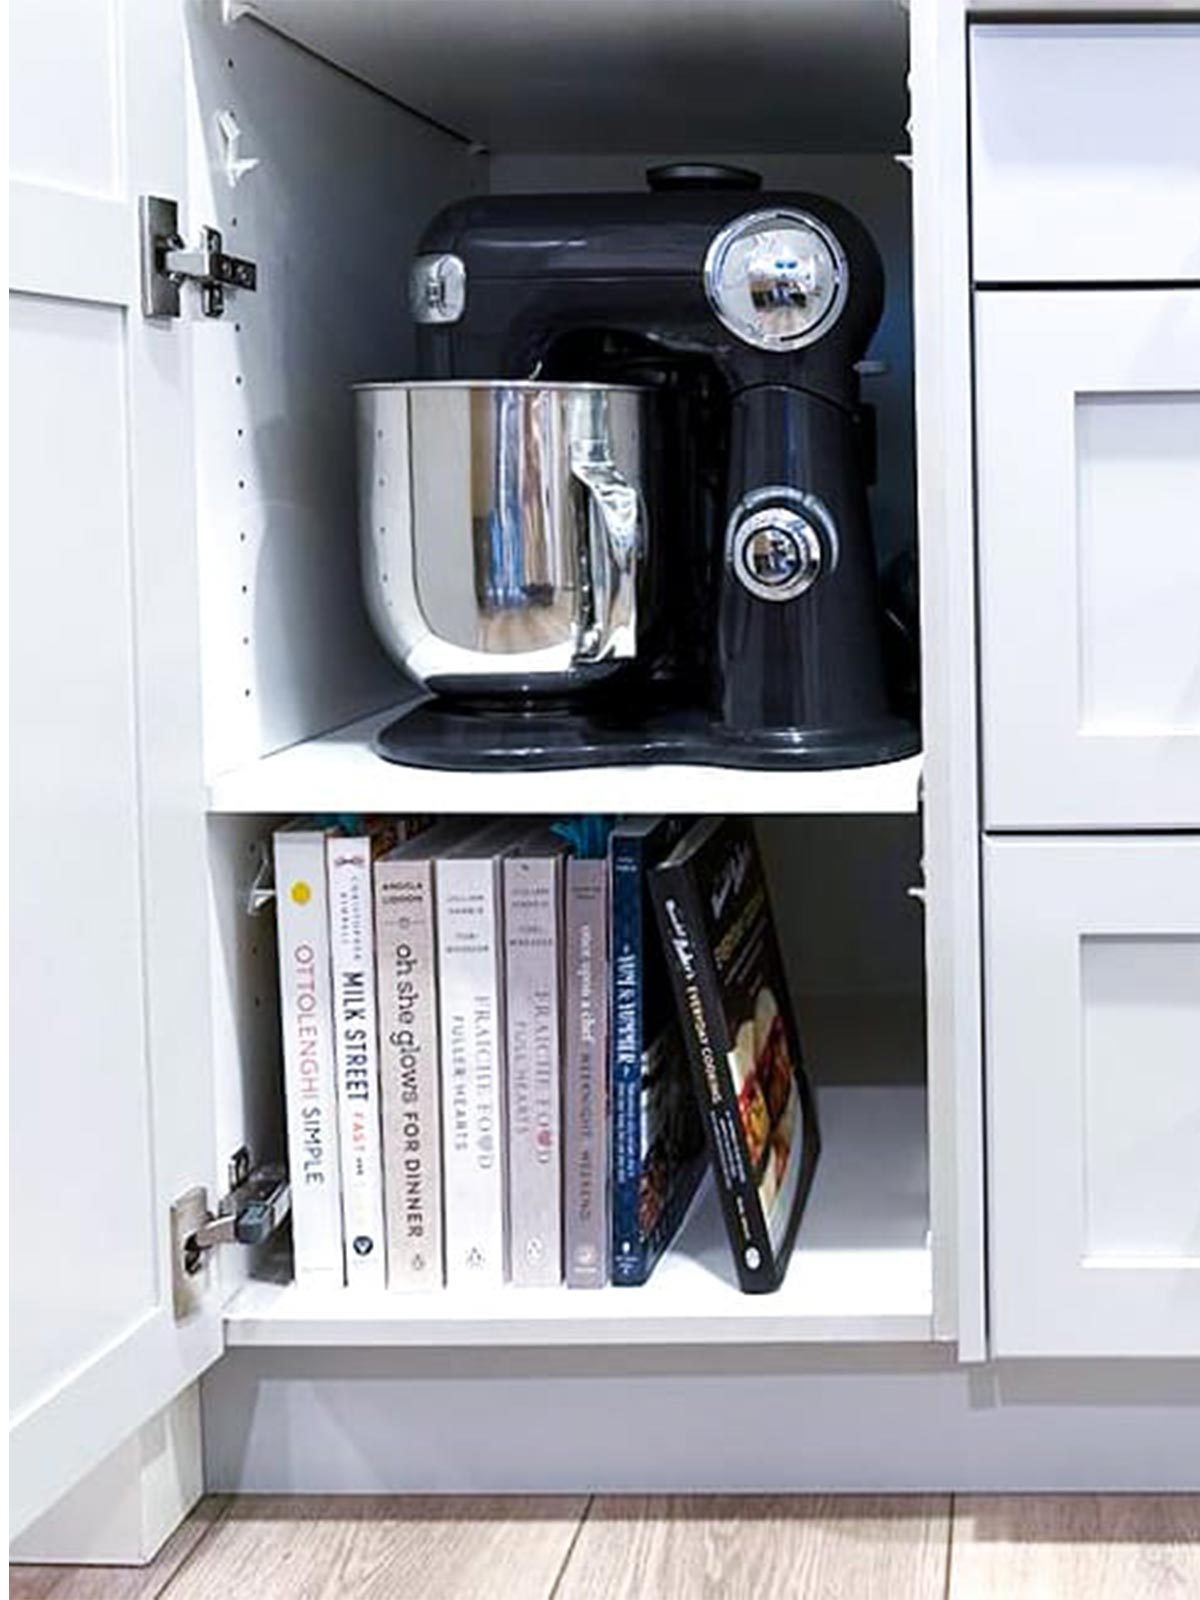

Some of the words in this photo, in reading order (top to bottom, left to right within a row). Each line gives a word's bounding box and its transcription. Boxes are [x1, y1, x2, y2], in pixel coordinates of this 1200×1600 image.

[396, 943, 417, 977] oh
[294, 944, 319, 1099] OTTOLENGHI
[342, 971, 366, 1022] MILK
[396, 981, 420, 1025] she
[580, 1011, 596, 1043] chef
[344, 1029, 369, 1102] STREET
[389, 1029, 421, 1104] glows
[686, 985, 709, 1044] EVERYDAY
[701, 1046, 723, 1104] COOKING
[301, 1106, 325, 1186] SIMPLE
[352, 1112, 365, 1151] FAST
[402, 1111, 421, 1154] FOR
[404, 1158, 424, 1239] DINNER
